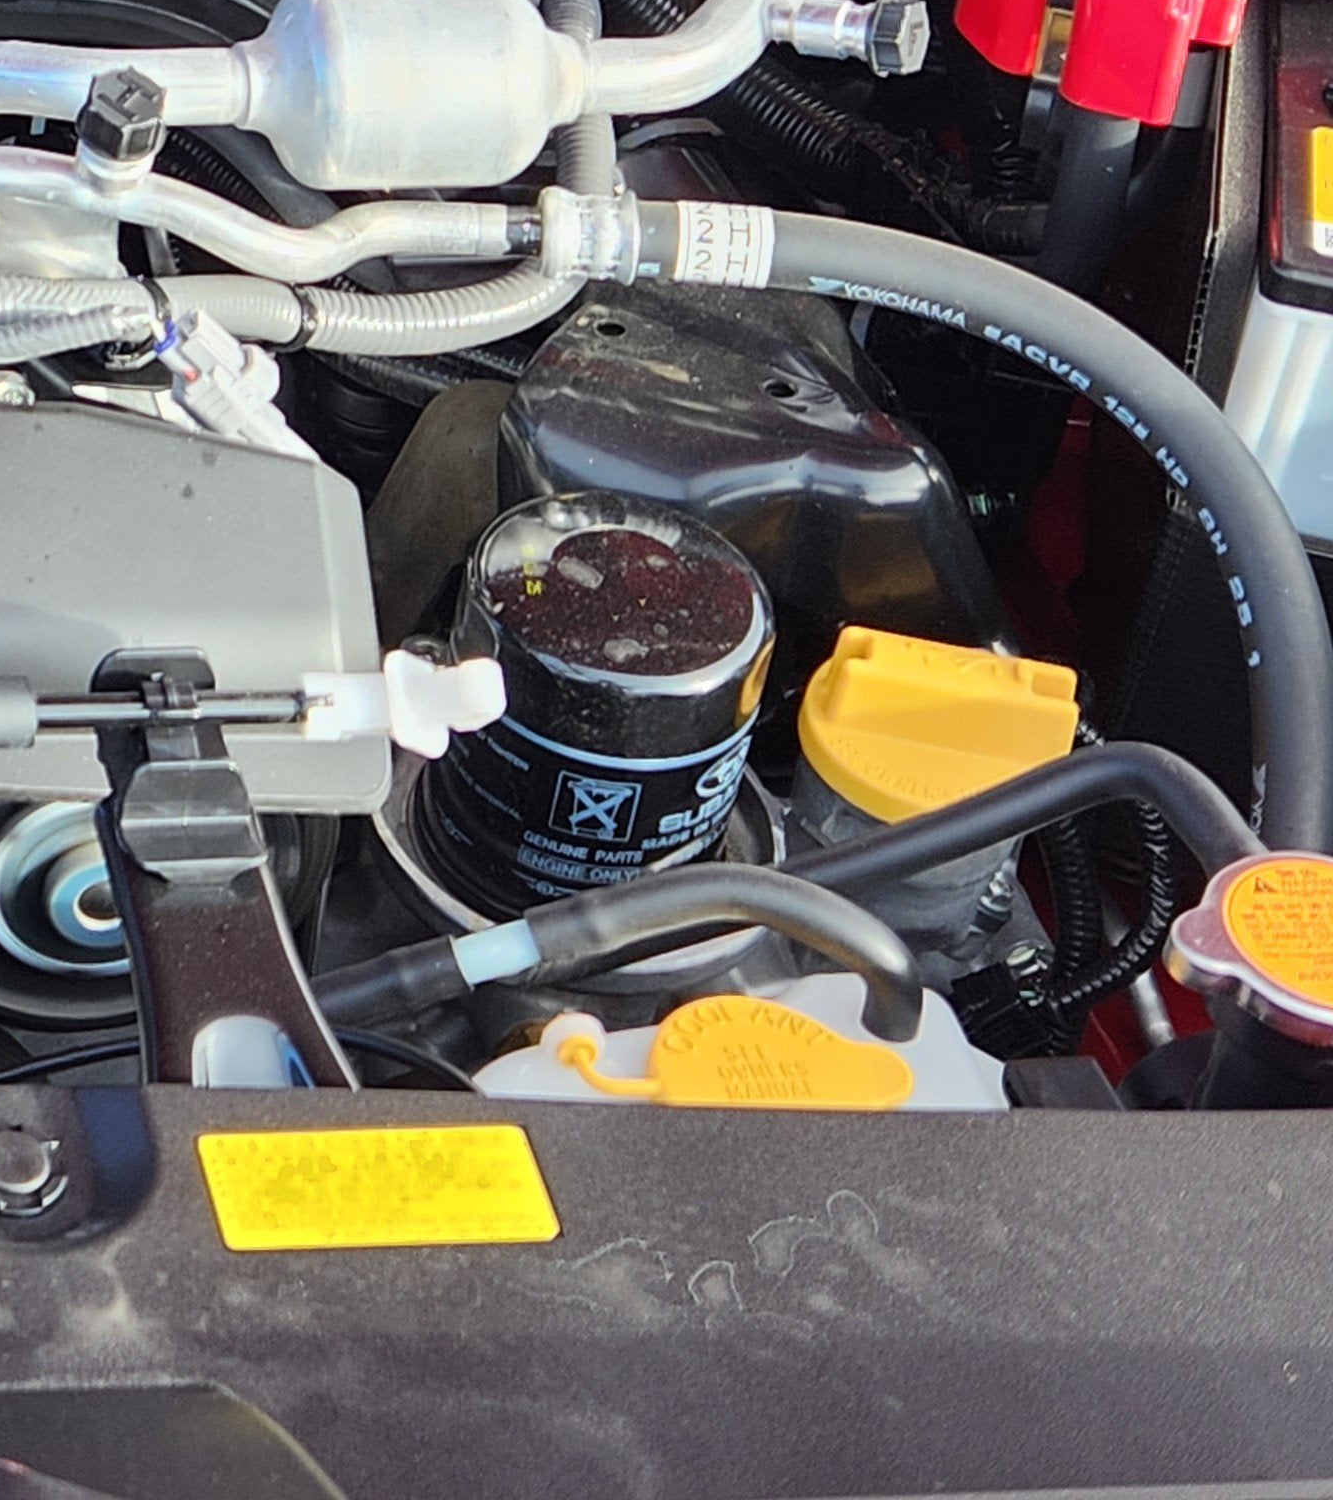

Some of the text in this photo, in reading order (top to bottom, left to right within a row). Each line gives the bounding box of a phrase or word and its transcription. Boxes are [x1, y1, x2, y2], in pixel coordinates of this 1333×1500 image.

[696, 218, 751, 247] 2 H
[695, 250, 749, 277] 2 H
[843, 281, 967, 330] YOKOHAMA
[523, 829, 644, 865] GENUINE PARTS
[641, 828, 691, 851] MADE
[520, 846, 583, 879] ENGINE
